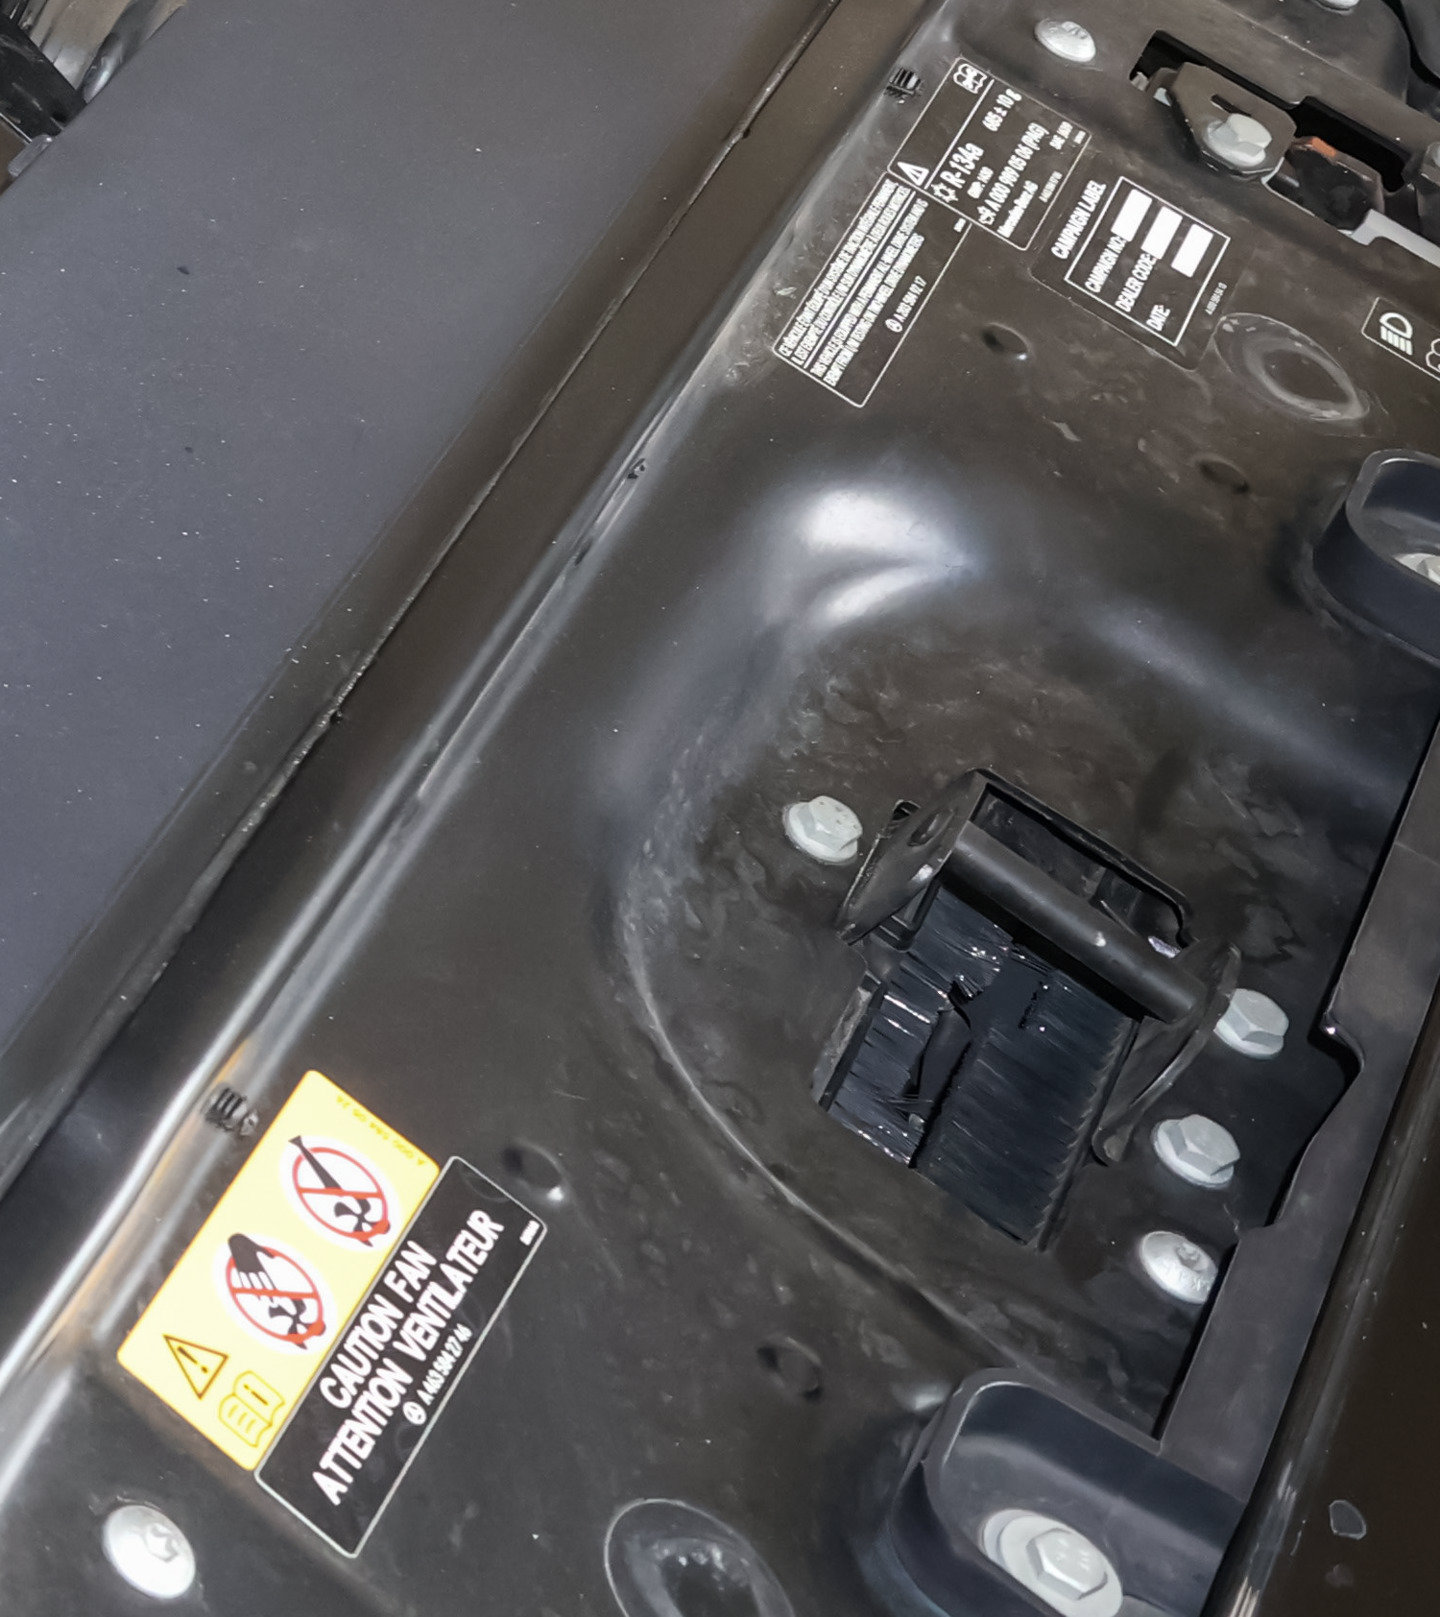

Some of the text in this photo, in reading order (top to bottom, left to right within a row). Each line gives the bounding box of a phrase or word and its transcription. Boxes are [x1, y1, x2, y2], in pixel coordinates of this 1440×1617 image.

[940, 143, 984, 189] R-134a
[996, 94, 1014, 109] 10
[1014, 143, 1034, 160] 06
[1021, 122, 1050, 150] (PAG)
[1008, 155, 1027, 171] 05
[984, 199, 1002, 212] A
[989, 182, 1011, 205] 000
[1051, 205, 1091, 259] CAMPAIGN
[1078, 180, 1106, 212] LABEL
[1084, 232, 1128, 293] CAMPAIGN NO:
[1115, 250, 1158, 312] DEALER CODE:
[1146, 305, 1171, 331] DATE:
[319, 1240, 437, 1408] CAUTION FAN
[312, 1210, 504, 1506] ATTENTION VENTILATEUR
